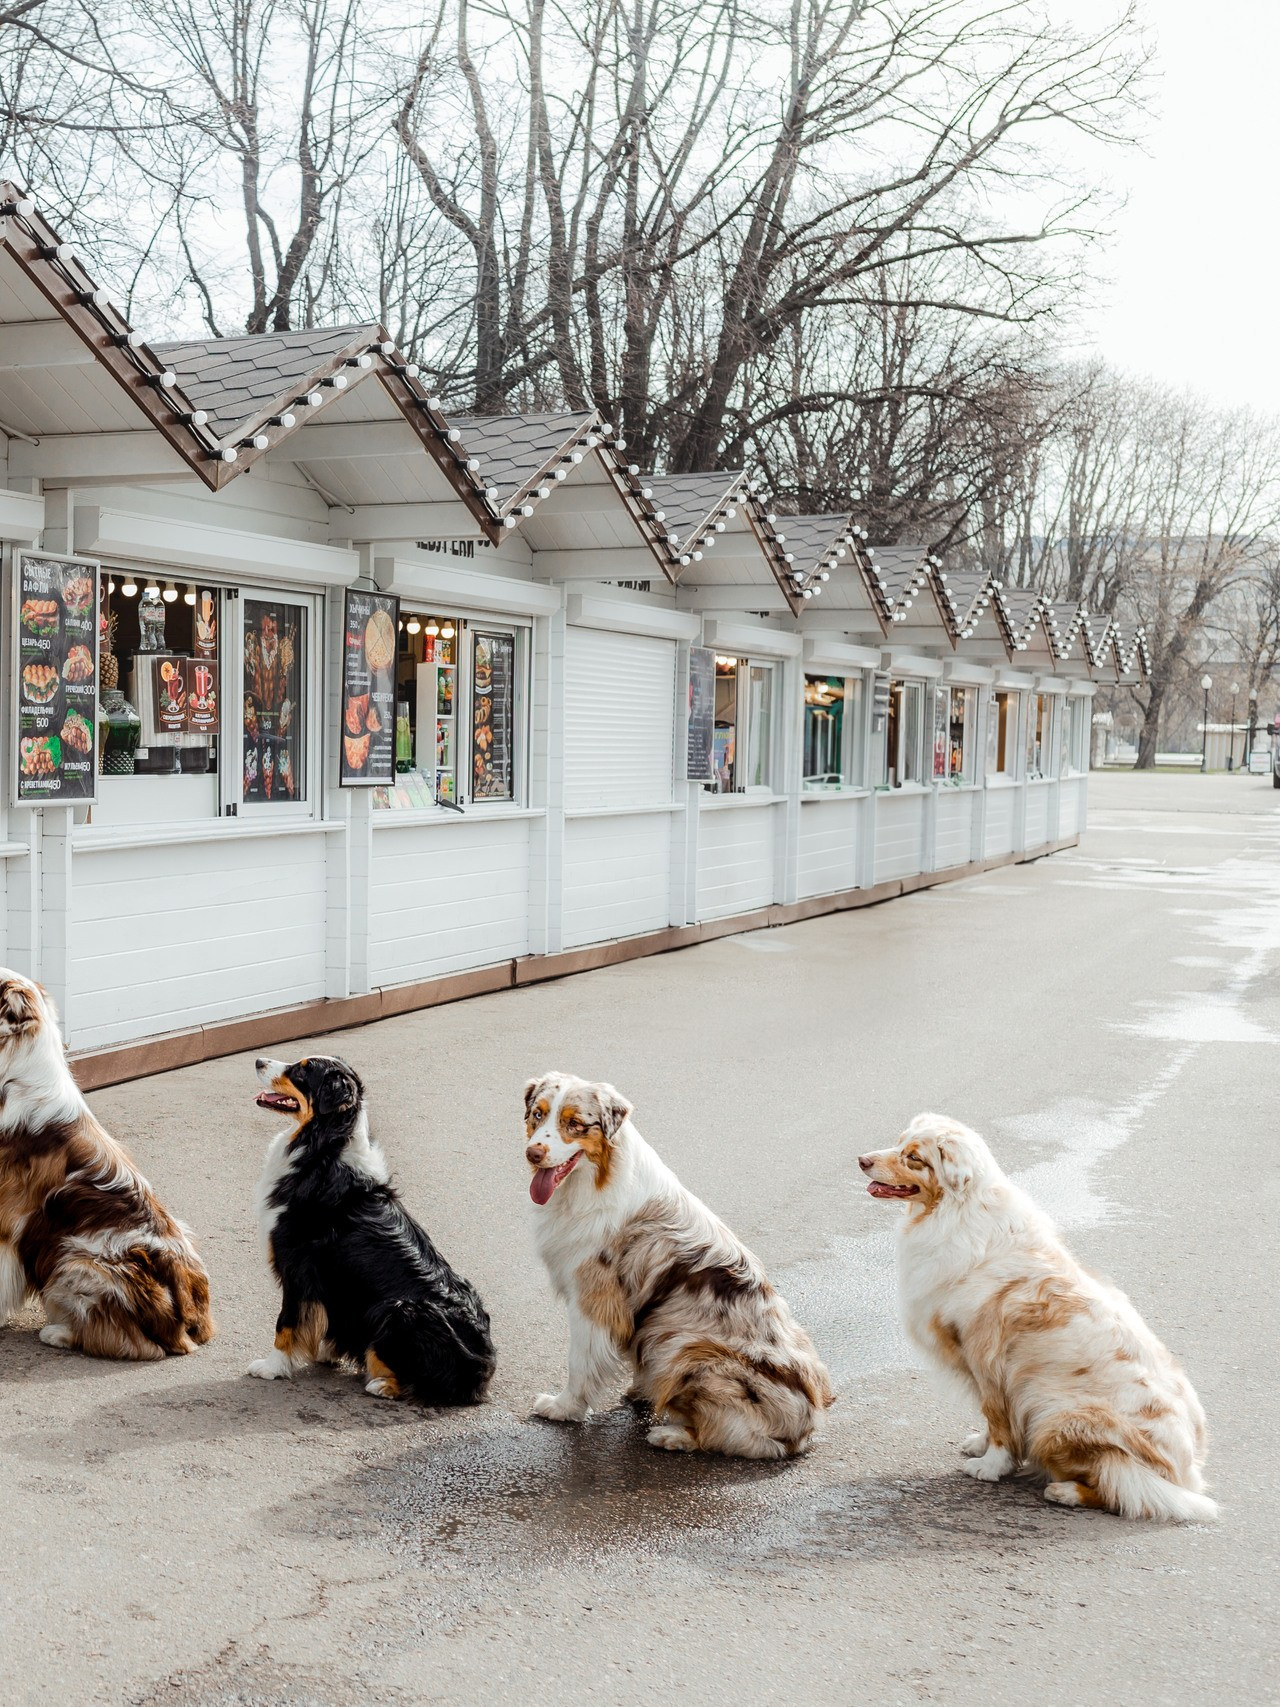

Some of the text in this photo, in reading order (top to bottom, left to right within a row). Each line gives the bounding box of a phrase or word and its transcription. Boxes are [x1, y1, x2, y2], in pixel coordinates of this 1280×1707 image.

[23, 580, 49, 594] ВАФЛИ
[37, 639, 51, 649] 450
[83, 685, 95, 695] 300
[36, 718, 49, 727] 500
